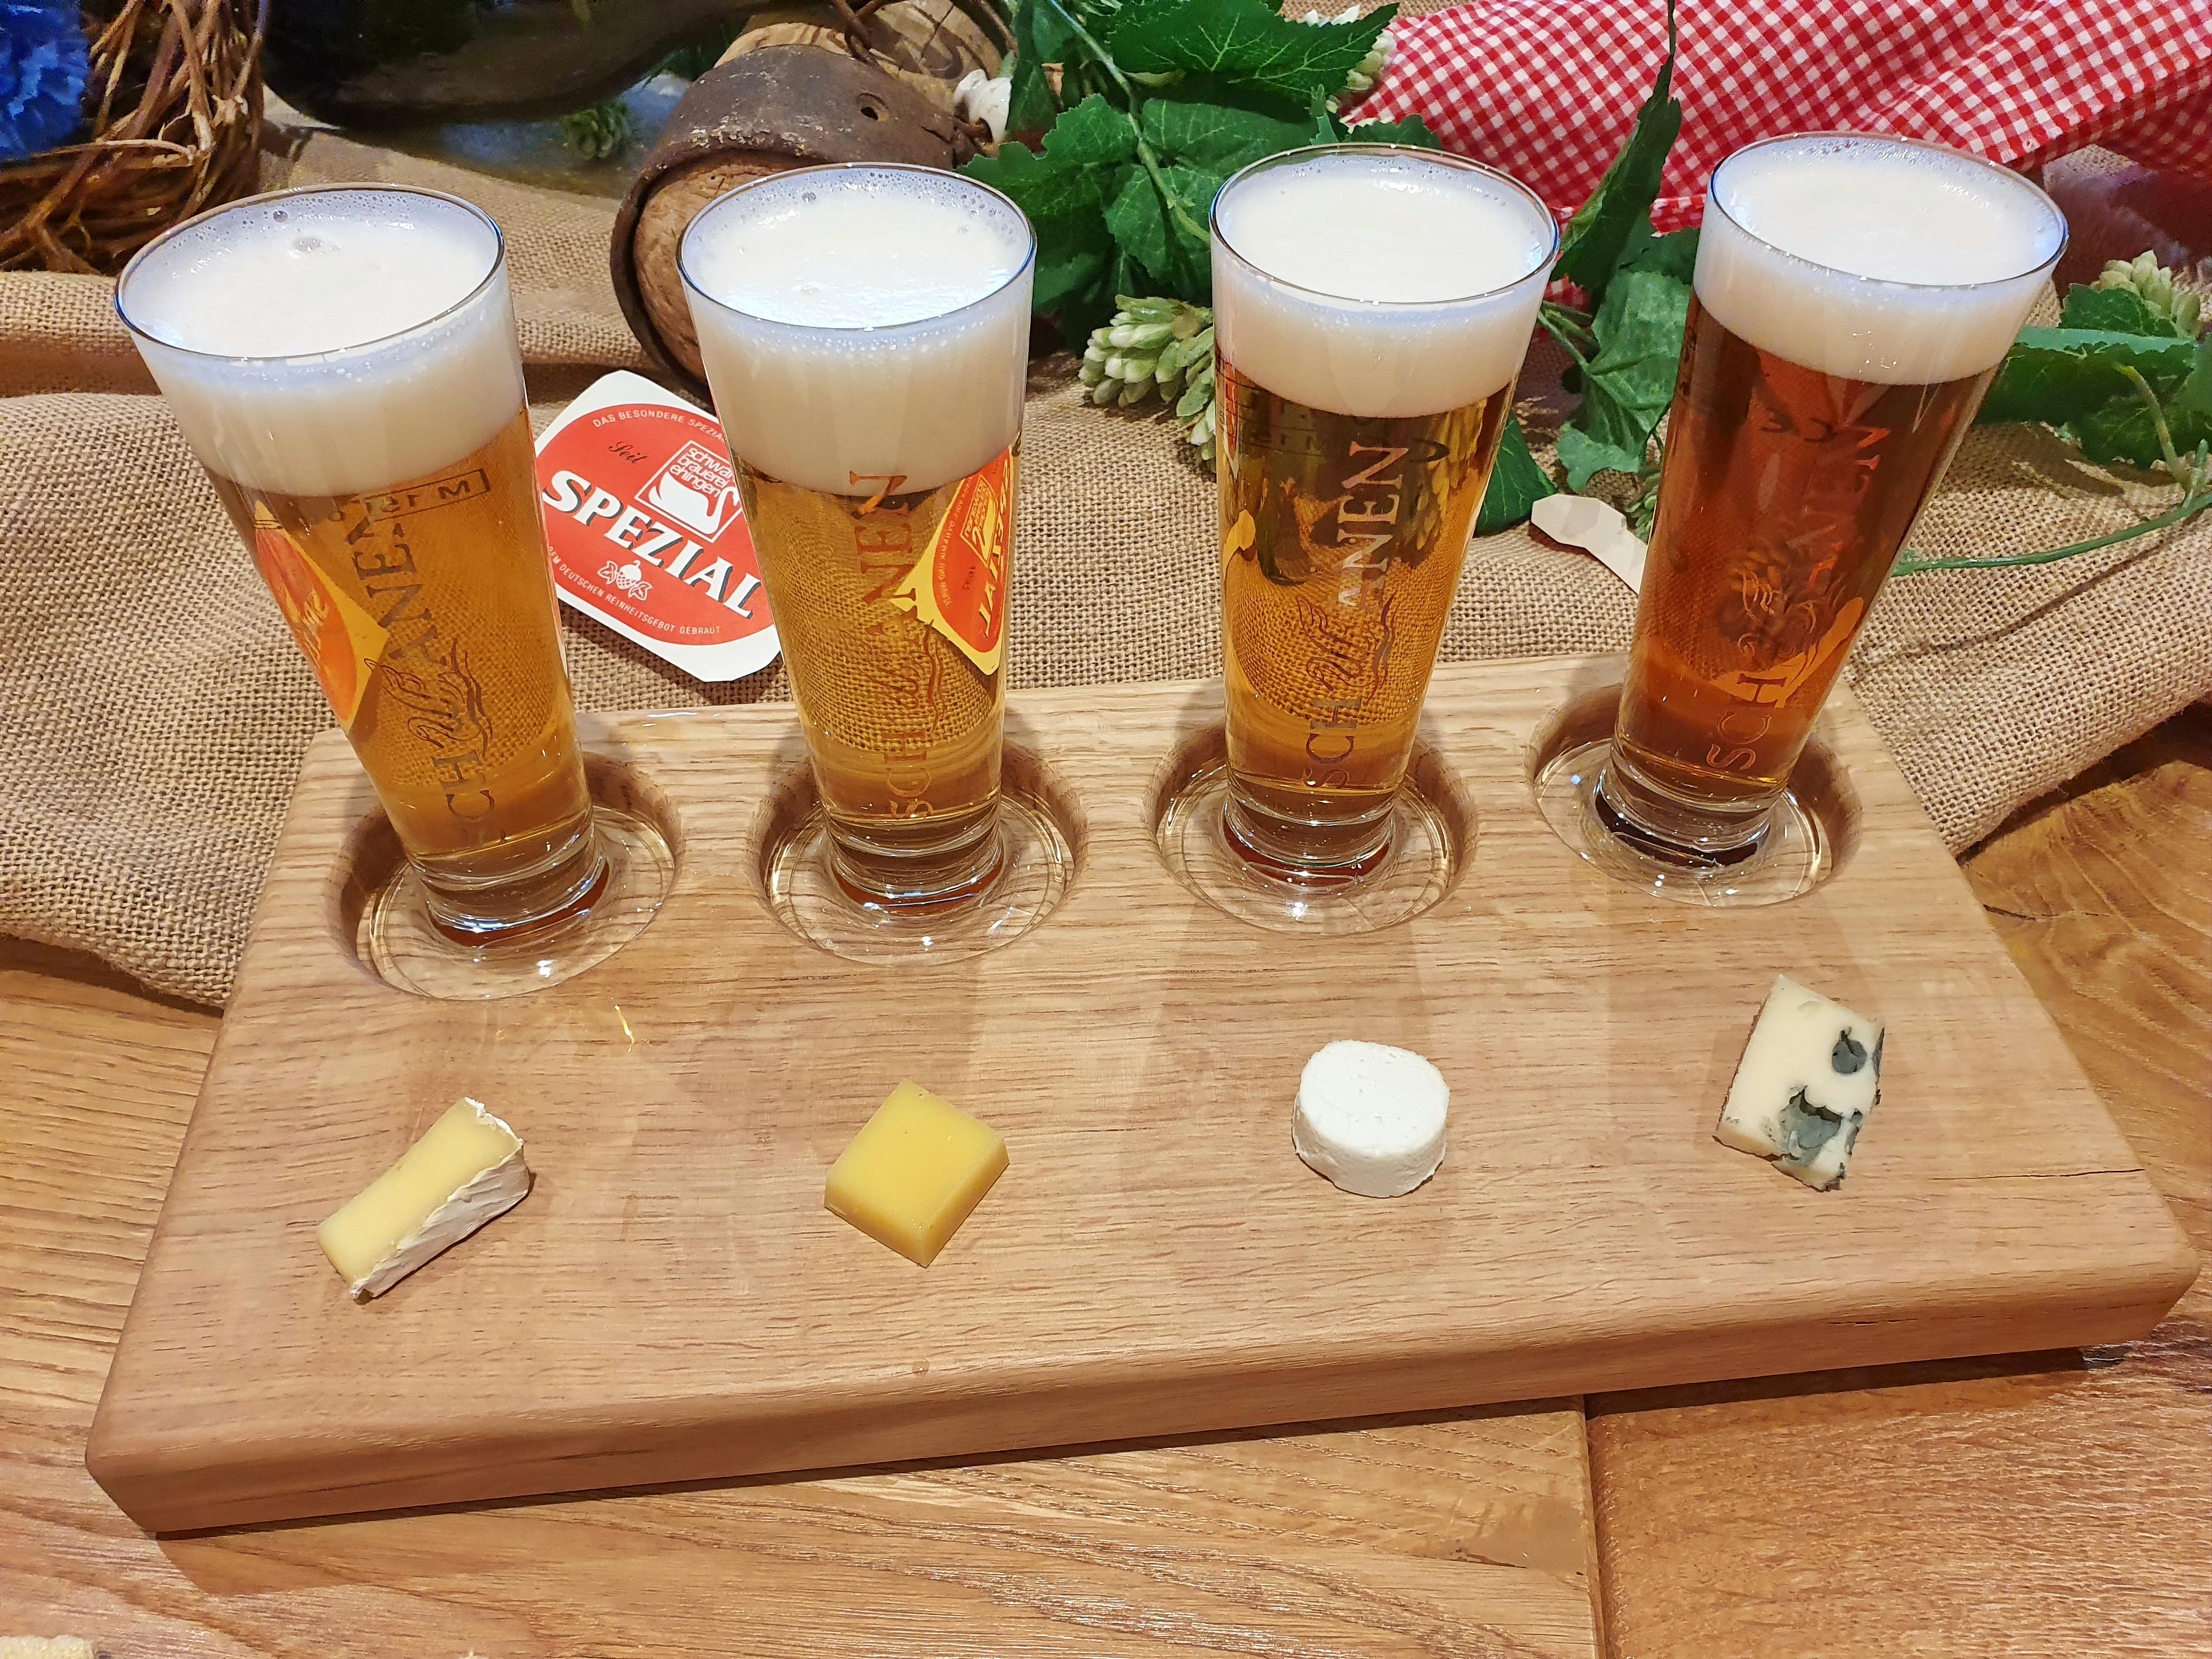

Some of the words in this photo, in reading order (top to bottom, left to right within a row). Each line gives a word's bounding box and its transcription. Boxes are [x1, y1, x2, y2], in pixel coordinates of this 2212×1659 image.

[592, 414, 616, 428] DAS
[619, 409, 685, 423] BESONDERE
[687, 419, 725, 443] SPEZIA
[608, 441, 648, 465] Seit
[686, 447, 734, 479] schwa
[669, 464, 721, 498] ehingen
[541, 470, 761, 619] SPEZIAL
[558, 563, 604, 597] DEUTSCHEN
[605, 592, 676, 633] REINHEITSGEBOT
[679, 625, 721, 636] GEBRAUT
